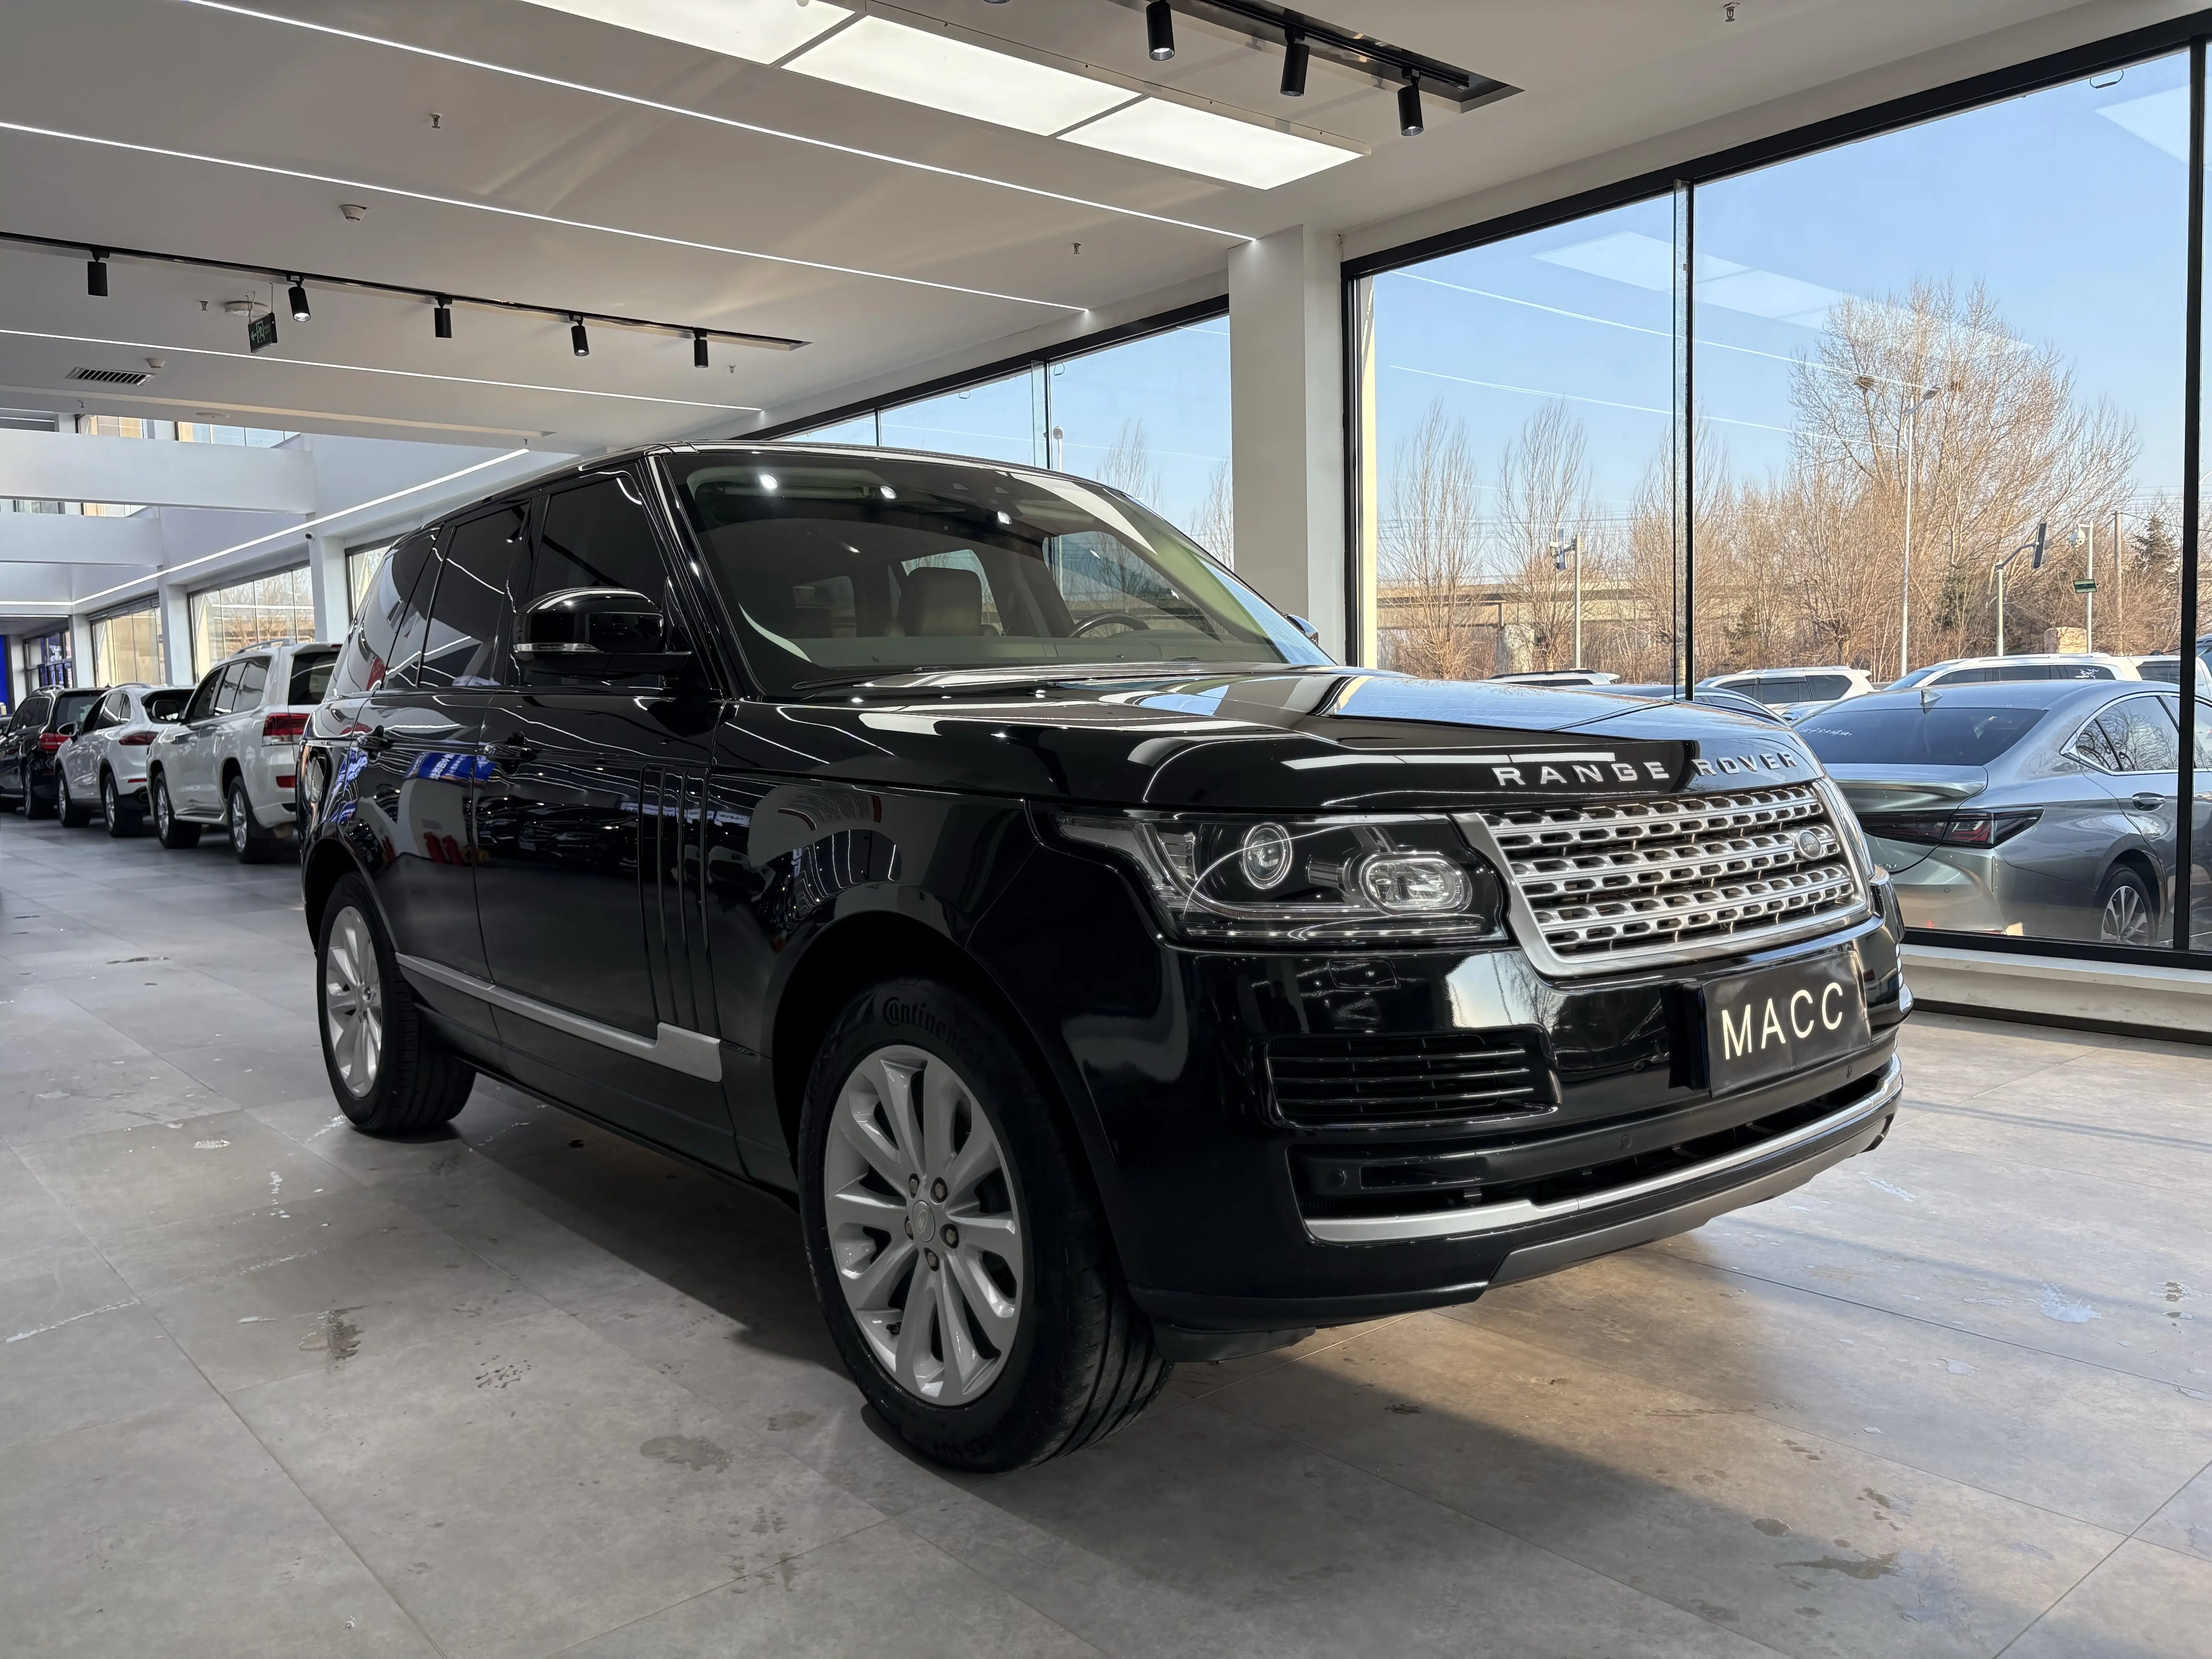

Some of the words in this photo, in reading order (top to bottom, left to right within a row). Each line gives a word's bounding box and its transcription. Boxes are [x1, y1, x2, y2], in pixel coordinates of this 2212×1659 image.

[1492, 762, 1669, 786] RANGE
[1691, 751, 1798, 776] ROVER
[883, 996, 972, 1064] Continen
[1722, 982, 1843, 1060] MACC
